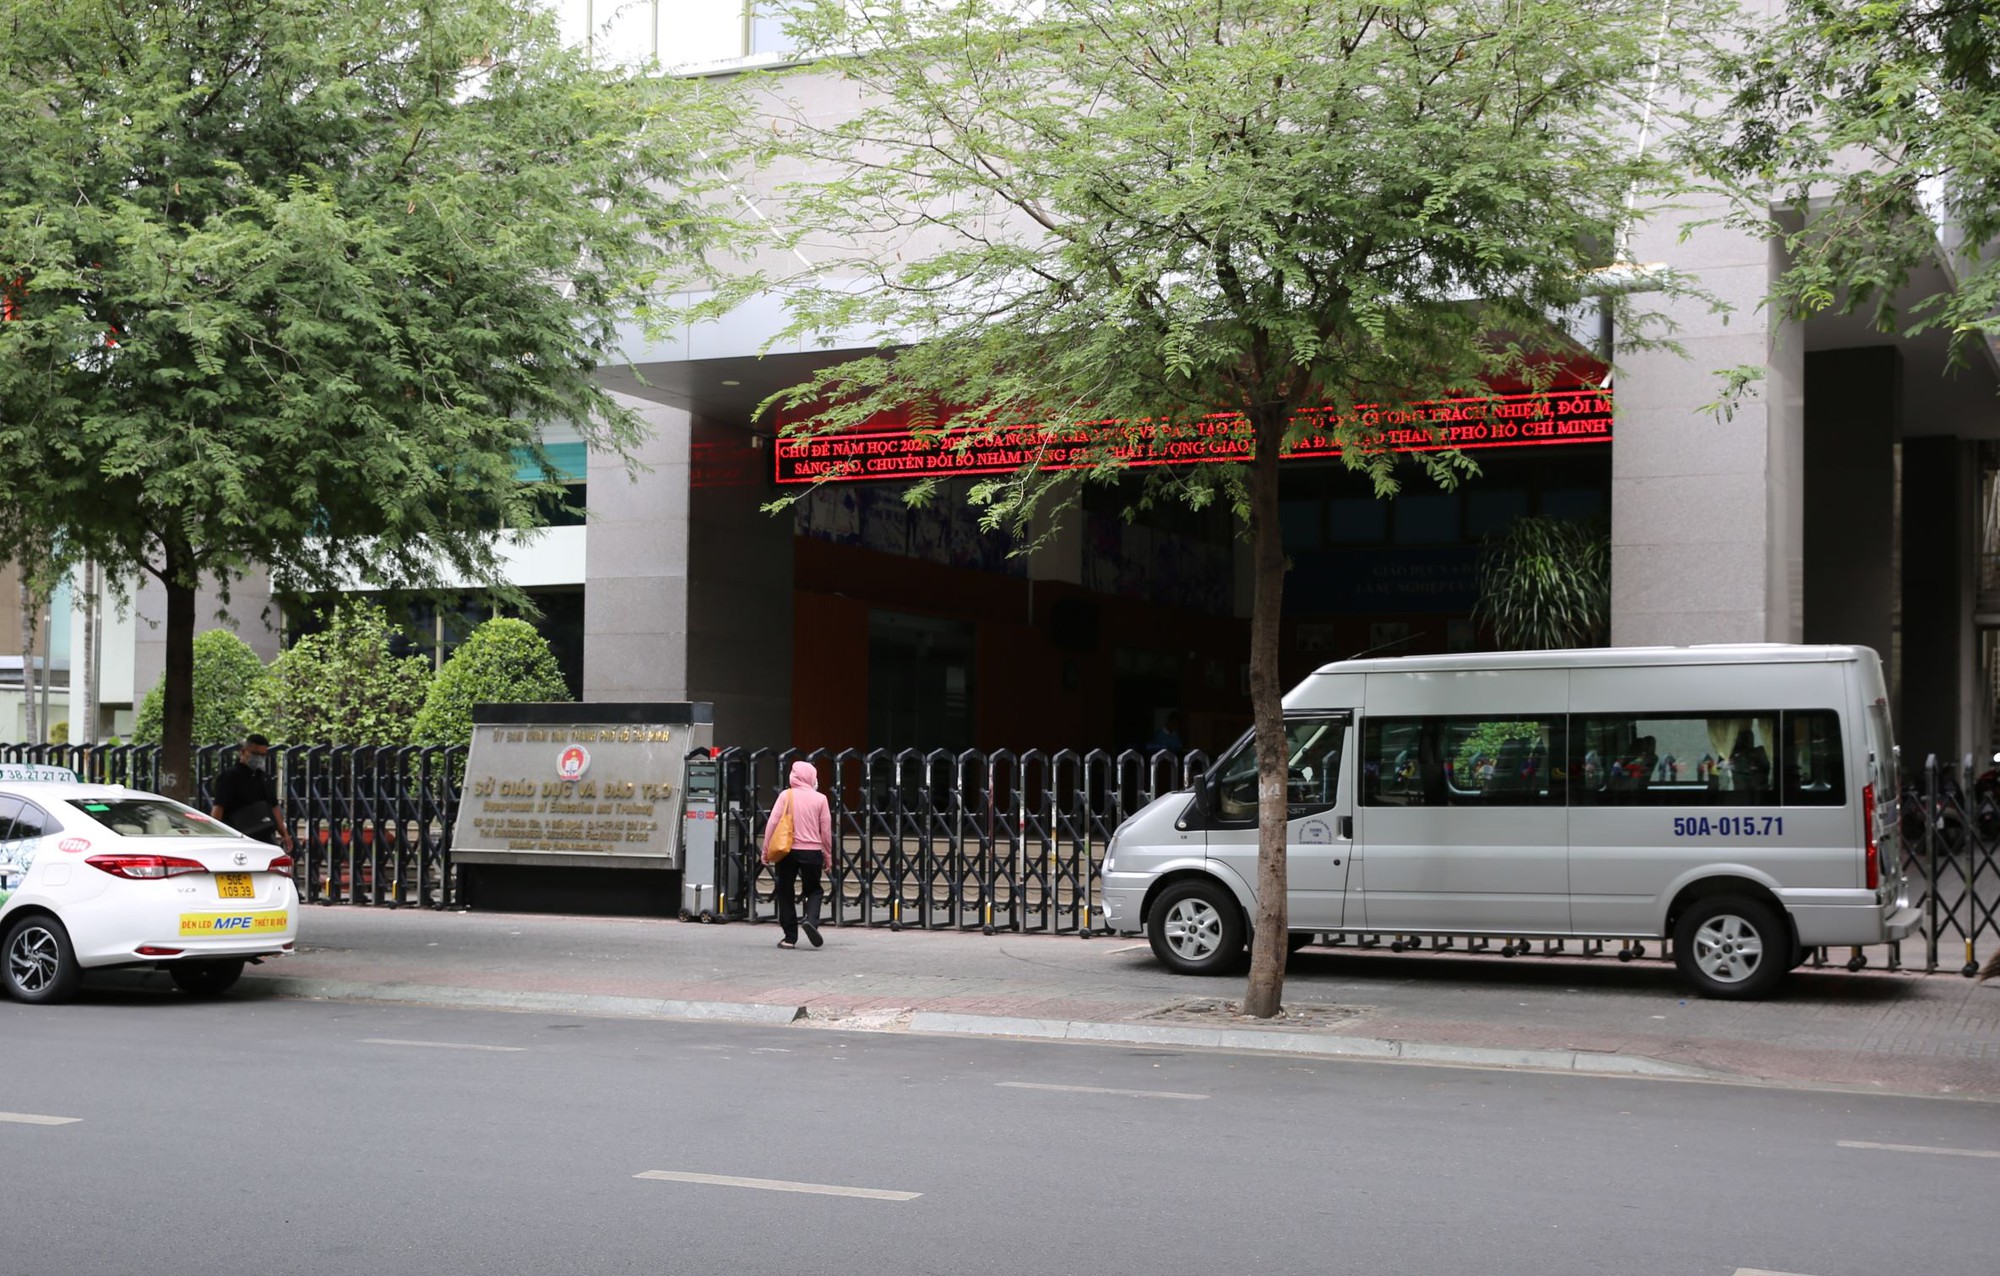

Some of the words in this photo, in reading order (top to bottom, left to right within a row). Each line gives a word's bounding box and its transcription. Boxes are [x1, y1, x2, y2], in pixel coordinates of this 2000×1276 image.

[795, 459, 831, 475] SÁNG
[1521, 418, 1554, 437] CHÍ
[833, 440, 864, 456] NĂM
[866, 440, 898, 456] HỌC
[900, 439, 931, 452] 2024
[499, 778, 536, 797] GIÁO
[541, 781, 573, 801] DỤC
[602, 779, 636, 799] ĐÀO
[641, 782, 673, 803] TẠO
[1674, 816, 1783, 836] 50A-015.71
[198, 919, 212, 929] LED
[213, 916, 253, 930] MPE
